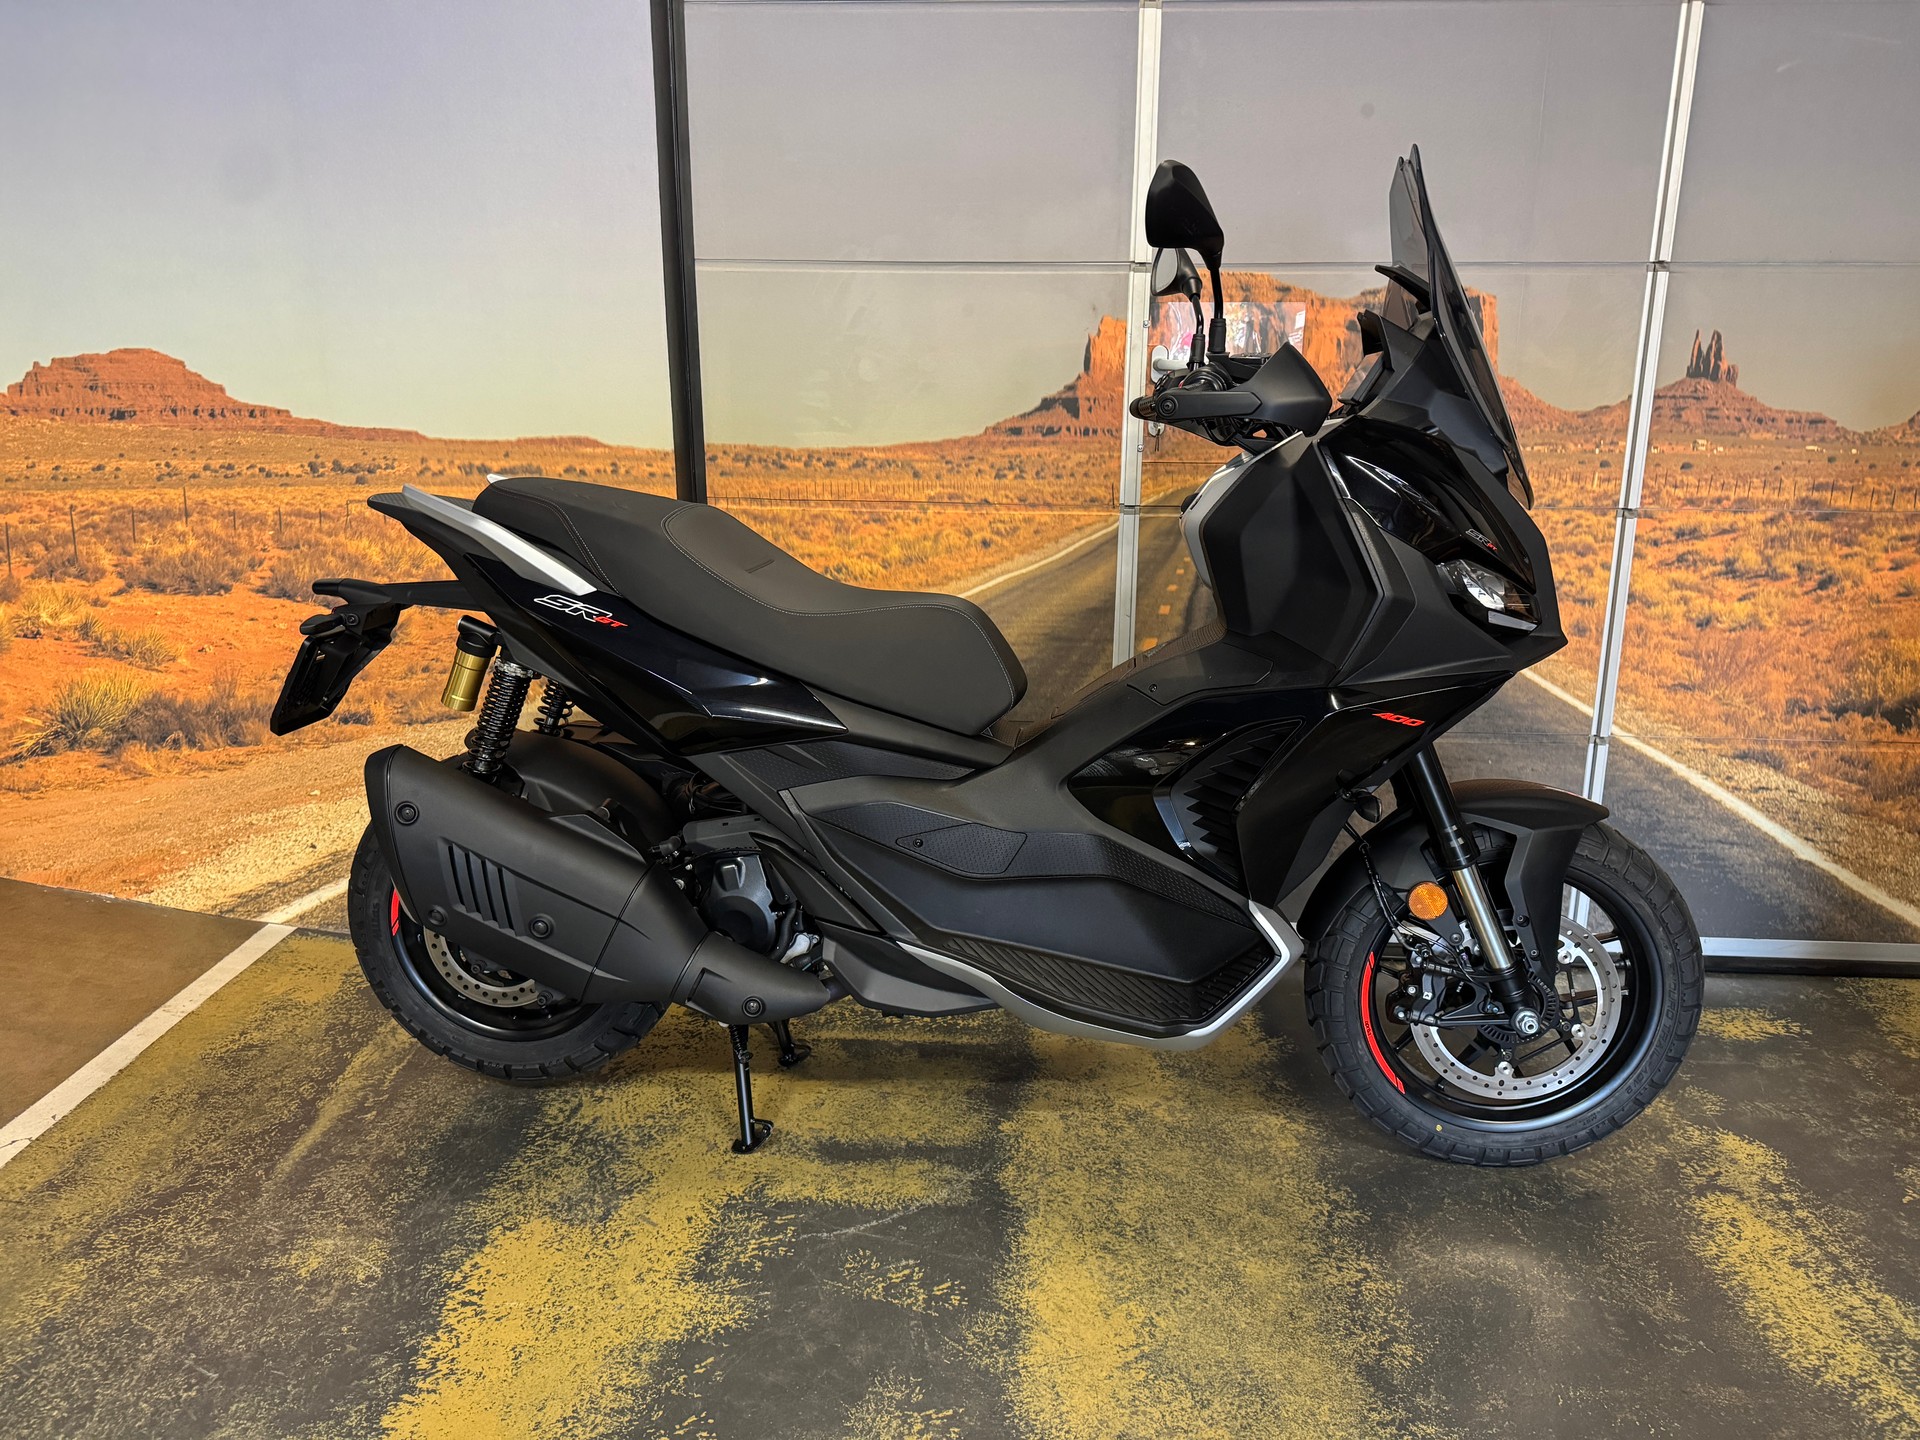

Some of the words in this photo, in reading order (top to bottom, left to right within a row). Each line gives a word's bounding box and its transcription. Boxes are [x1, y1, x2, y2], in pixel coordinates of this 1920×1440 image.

[533, 594, 613, 622] SR
[593, 616, 628, 627] GT
[1371, 712, 1425, 727] 400
